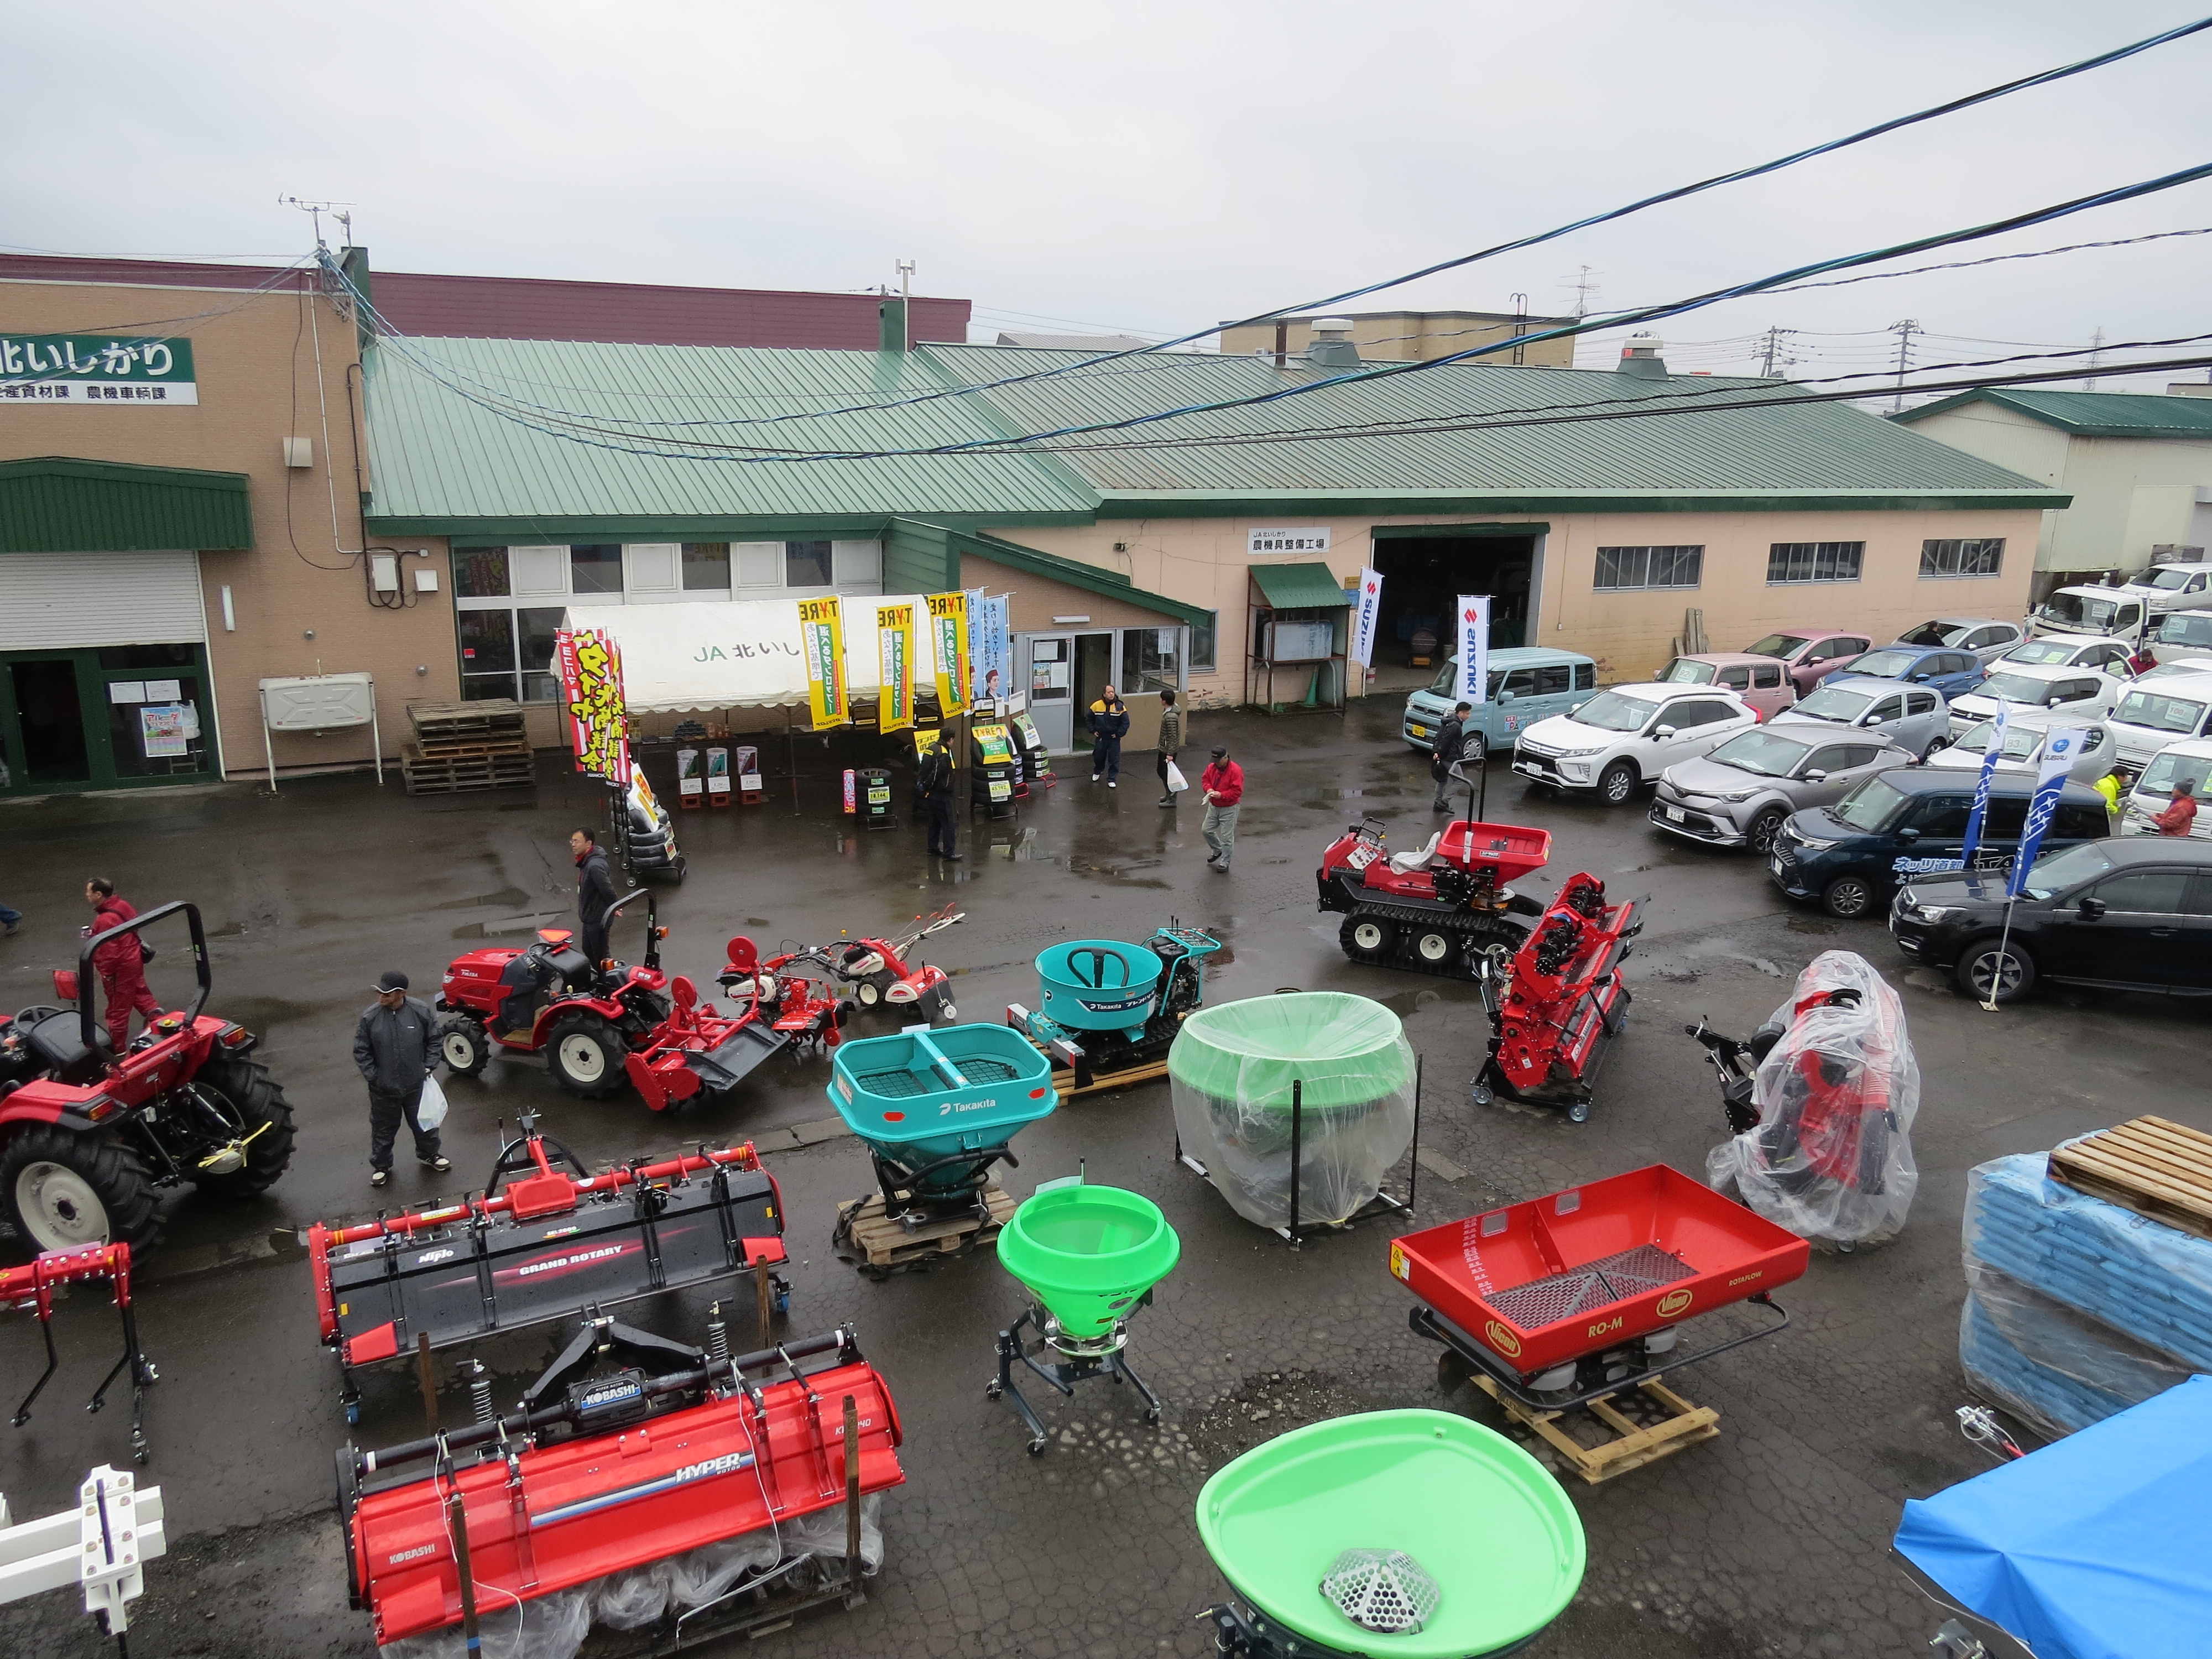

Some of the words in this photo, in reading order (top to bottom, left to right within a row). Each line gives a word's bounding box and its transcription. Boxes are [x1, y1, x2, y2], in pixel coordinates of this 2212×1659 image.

[0, 385, 71, 399] 産資材課
[1253, 538, 1325, 551] 農機具整備工場
[693, 645, 728, 662] JA
[418, 1249, 455, 1264] Niplo
[519, 1258, 568, 1276] GRAND
[569, 1245, 623, 1264] ROTARY
[1728, 1270, 1763, 1287] ROTAFLOW
[1489, 1320, 1517, 1353] Vicon
[1588, 1316, 1623, 1338] RO-M
[586, 1384, 636, 1406] KOBASHI
[675, 1452, 742, 1483] HYPER
[389, 1543, 436, 1566] KOBASHI
